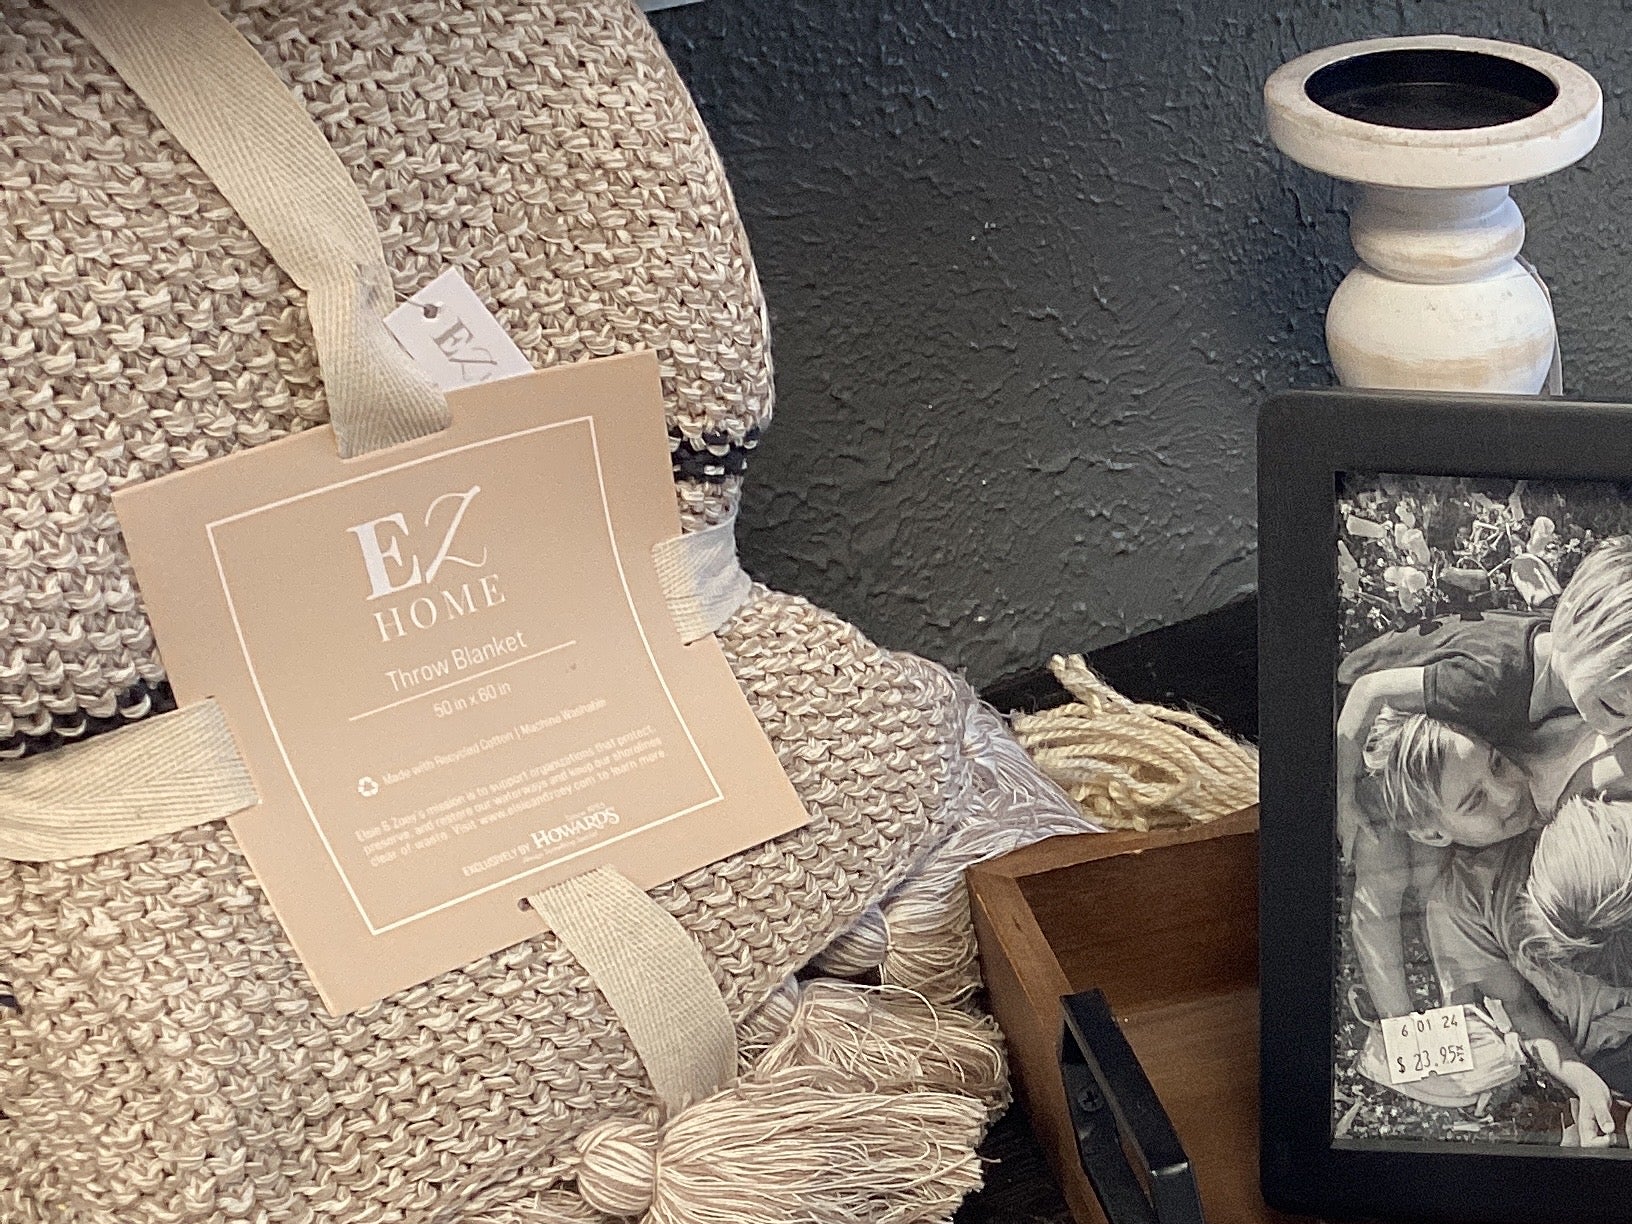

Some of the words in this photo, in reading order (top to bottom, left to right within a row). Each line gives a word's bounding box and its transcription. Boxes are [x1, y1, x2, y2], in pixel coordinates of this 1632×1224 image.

[346, 485, 487, 600] EZ
[373, 574, 505, 642] HOME
[385, 658, 449, 692] Throw
[451, 630, 527, 671] Blanket
[433, 700, 453, 718] 50
[455, 698, 468, 711] in
[470, 695, 479, 706] x
[478, 684, 497, 702] 60
[499, 682, 512, 696] in
[382, 766, 411, 784] Made
[410, 758, 434, 774] with
[479, 730, 513, 749] Cotton
[597, 770, 609, 781] to
[414, 820, 433, 834] and
[474, 800, 490, 812] our
[549, 771, 567, 784] and
[477, 786, 488, 796] to
[488, 771, 527, 793] support
[461, 848, 518, 876] EXCLUSIVELY
[517, 843, 530, 855] BY
[1401, 1025, 1408, 1037] 6
[1442, 1014, 1458, 1028] 24
